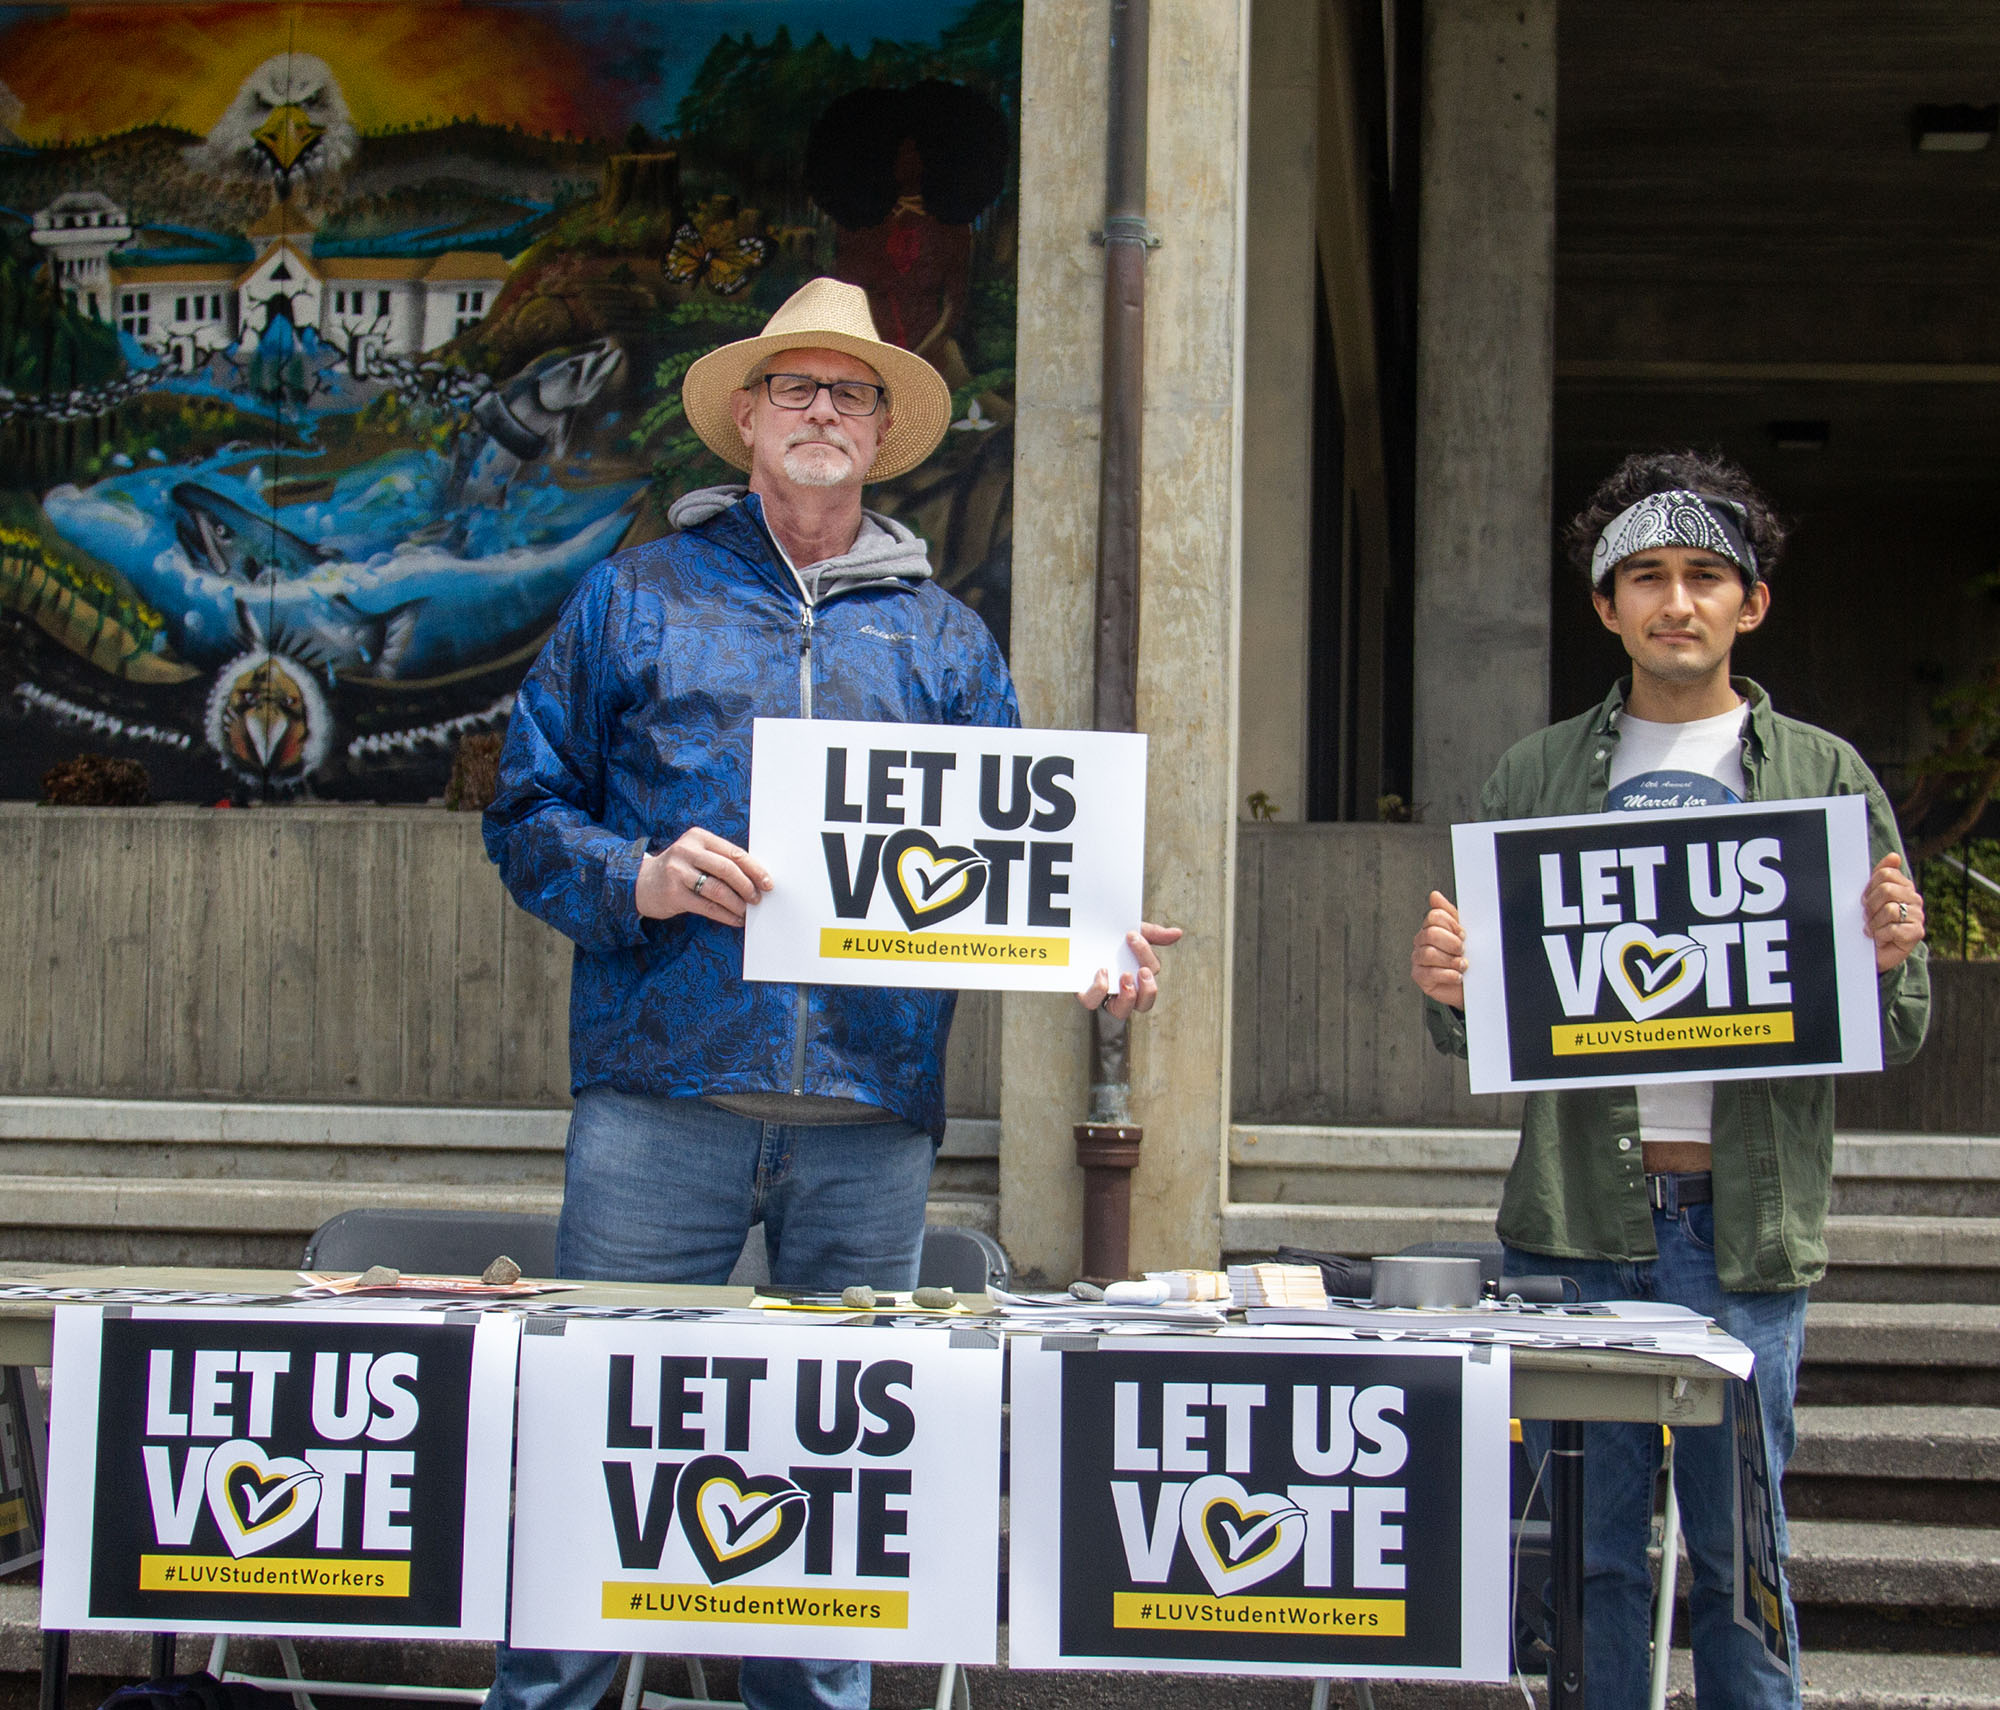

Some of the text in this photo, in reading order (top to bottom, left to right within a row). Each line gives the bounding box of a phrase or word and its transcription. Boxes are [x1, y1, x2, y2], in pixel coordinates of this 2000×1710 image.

[824, 747, 1077, 833] LET US
[1623, 794, 1707, 809] March for
[1539, 837, 1788, 928] LET US
[842, 936, 1048, 960] #LUVStudentWorkers
[1574, 1023, 1772, 1048] #LUVStudentWorkers
[146, 1349, 420, 1441] LET US
[606, 1354, 916, 1457] LET US
[1113, 1381, 1409, 1478] LET US
[164, 1565, 385, 1588] #LUVStudentWorkers
[629, 1593, 881, 1620] #LUVStudentWorkers
[1140, 1602, 1379, 1627] #LUVStudentWorkers
